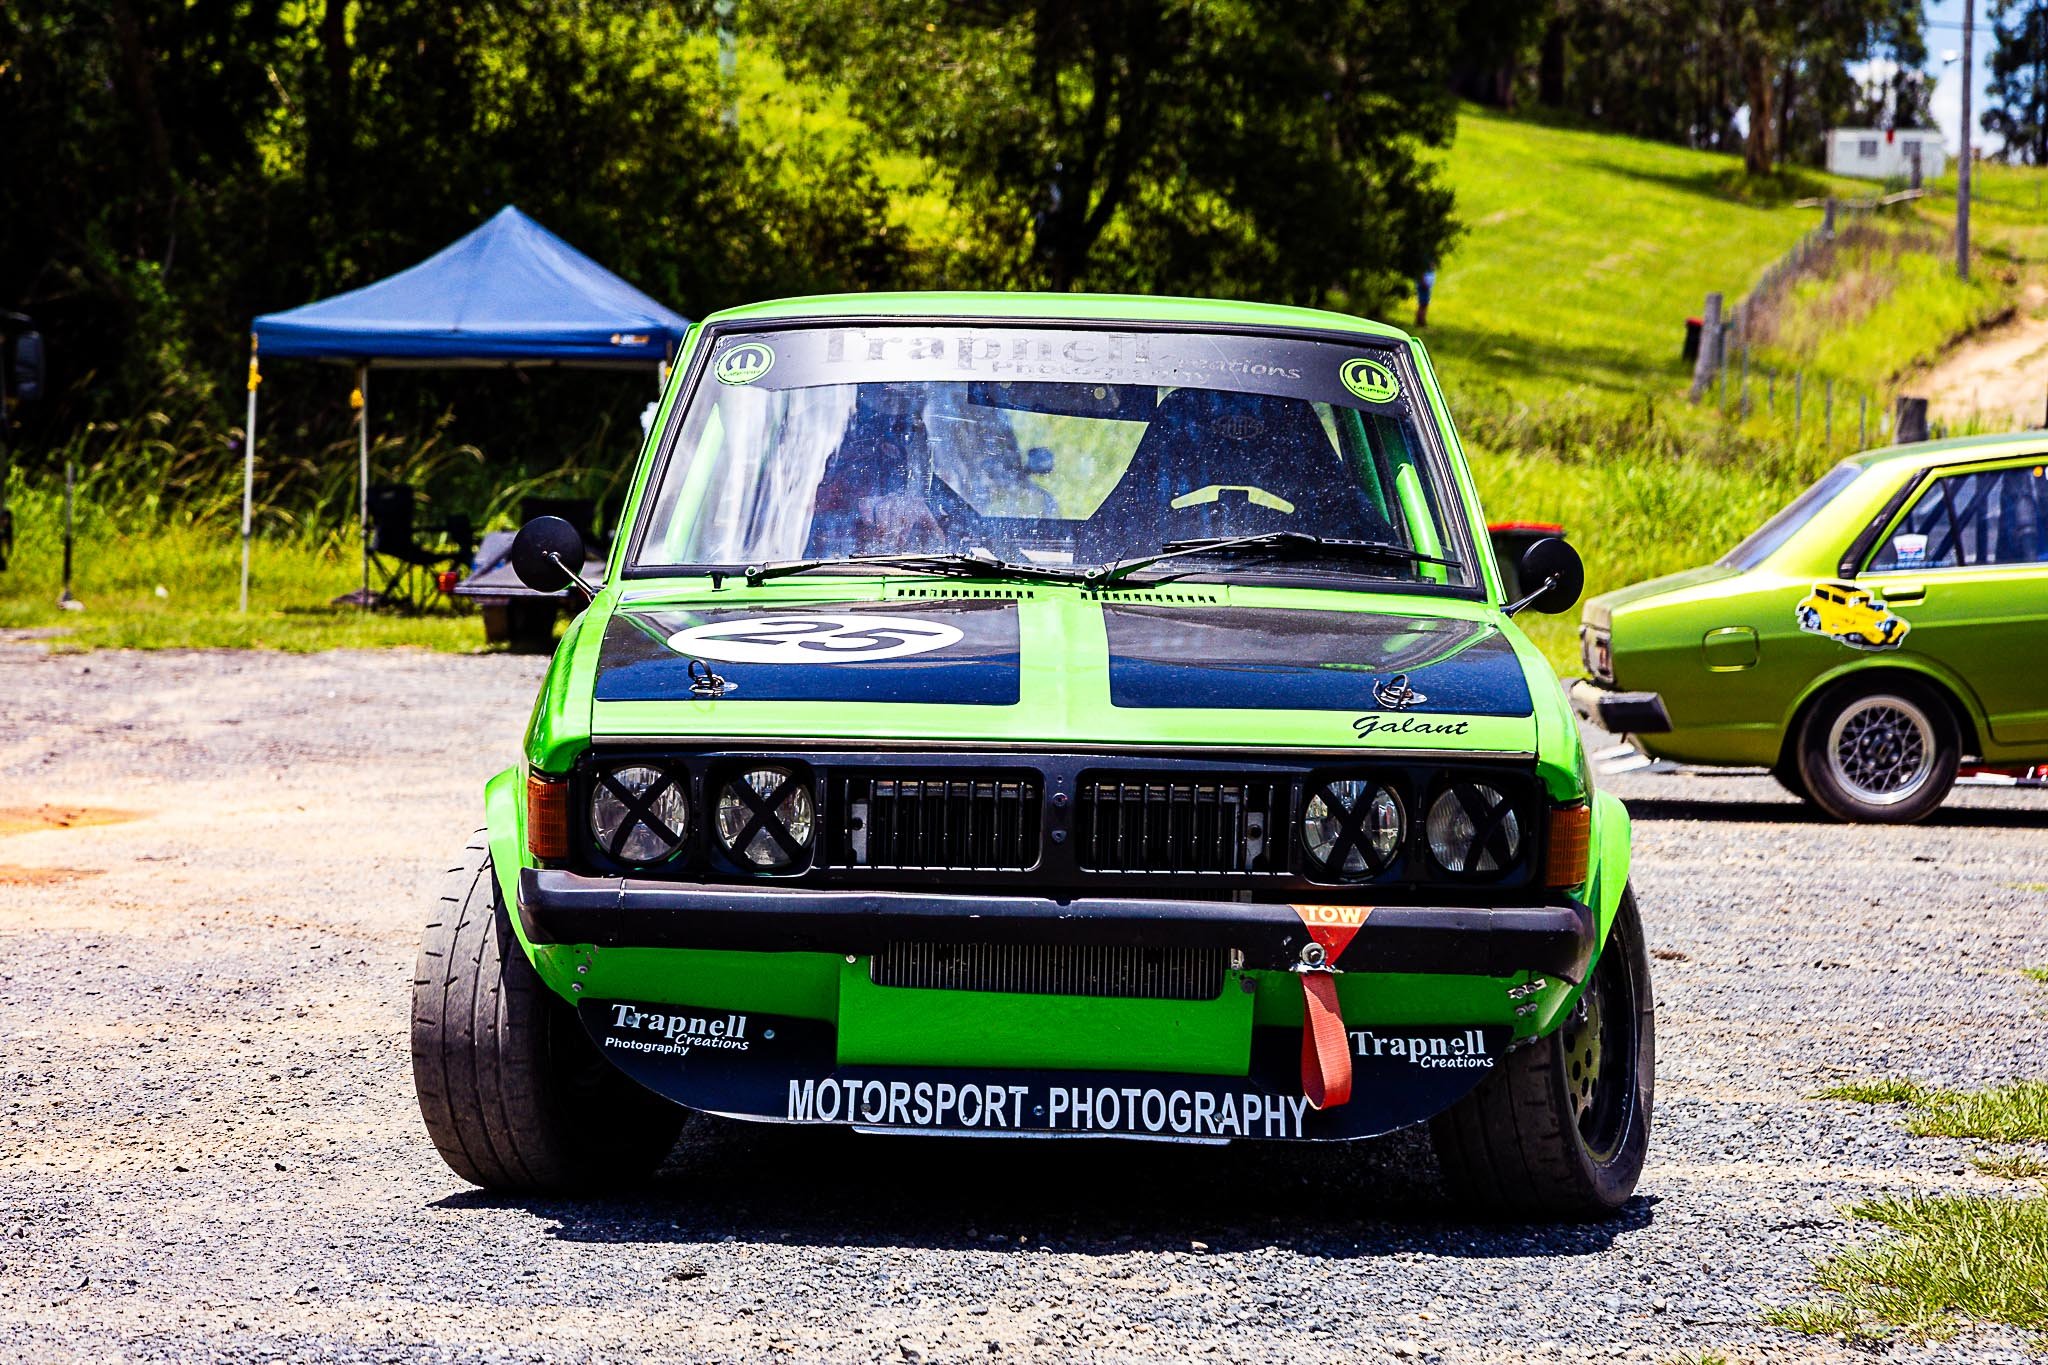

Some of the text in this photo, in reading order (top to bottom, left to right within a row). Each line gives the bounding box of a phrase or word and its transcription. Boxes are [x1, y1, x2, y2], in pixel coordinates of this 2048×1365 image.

[696, 621, 943, 652] 25
[1352, 715, 1469, 739] Galant
[1304, 905, 1362, 924] TOW
[611, 1003, 747, 1039] Trapnell
[604, 1037, 690, 1056] Photography
[675, 1033, 750, 1051] Creations
[1350, 1029, 1486, 1062] Trapnell
[1420, 1055, 1494, 1068] Creations
[787, 1078, 1308, 1137] MOTORSPORT PHOTOGRAPHY
